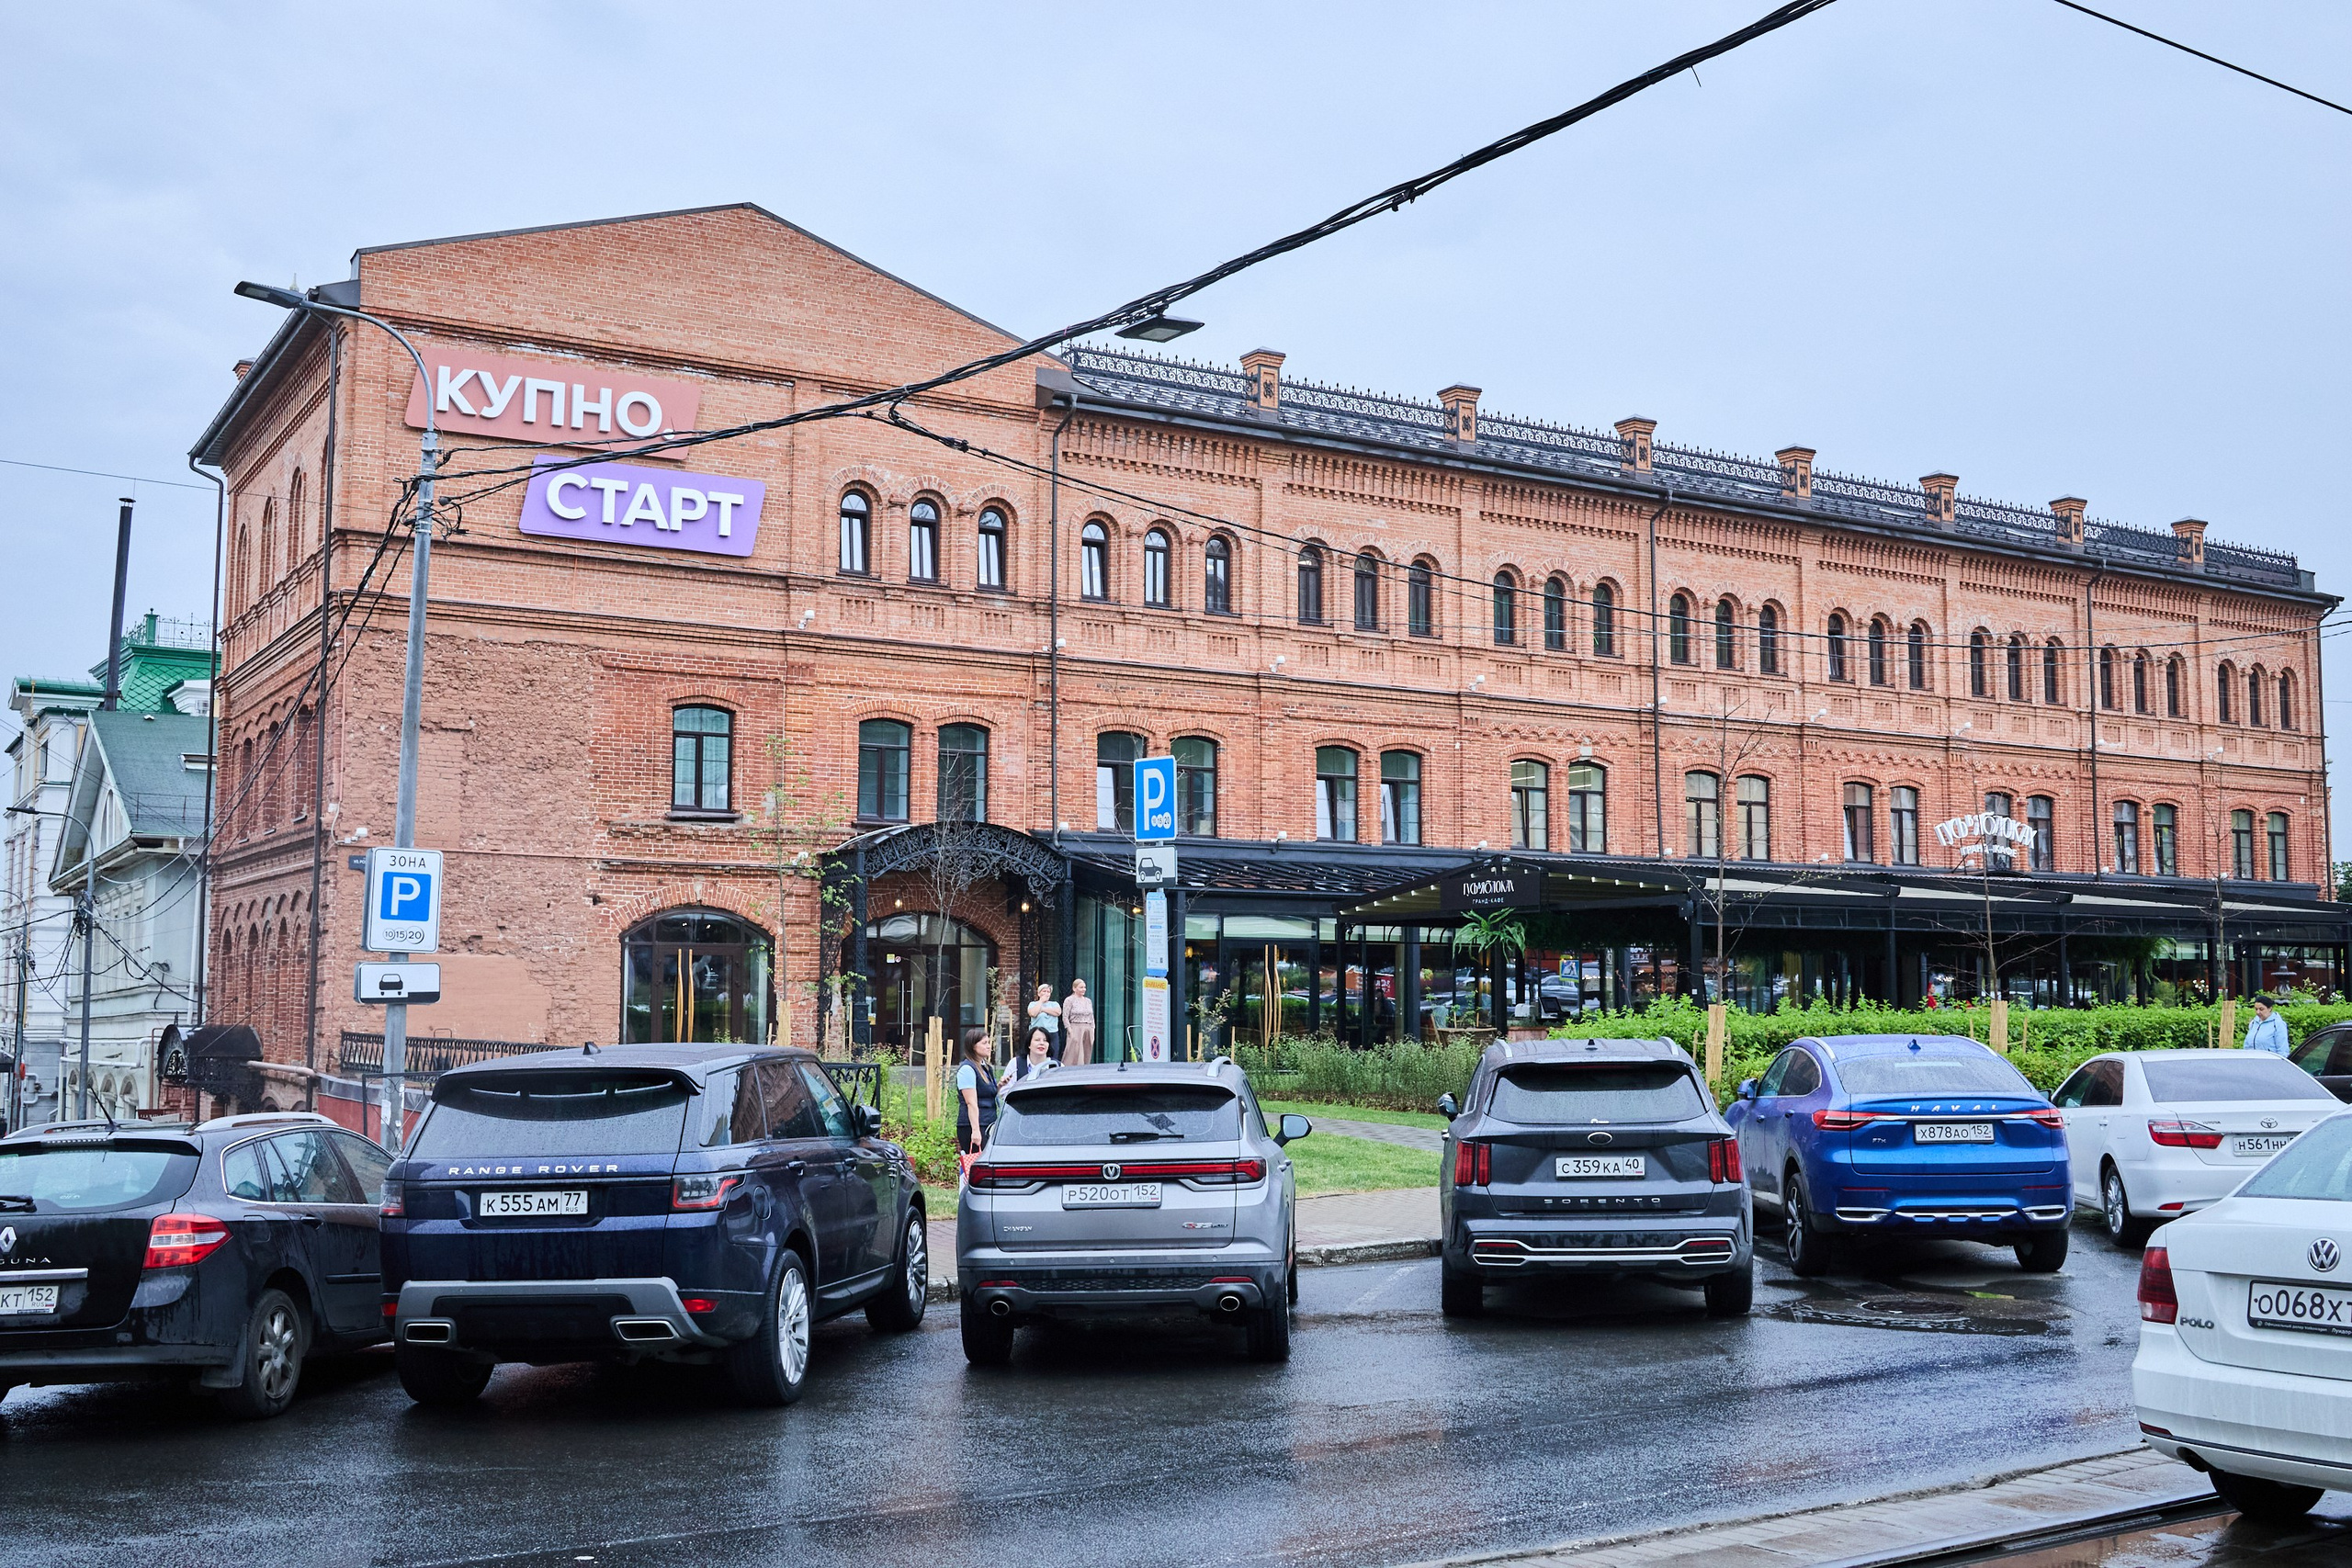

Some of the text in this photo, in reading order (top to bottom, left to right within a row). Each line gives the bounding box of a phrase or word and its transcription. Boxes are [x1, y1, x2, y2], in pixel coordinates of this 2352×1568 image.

[546, 472, 745, 537] СТАРТ
[1143, 768, 1166, 831] P
[1164, 816, 1170, 825] 20
[1960, 842, 2018, 858] ГРАНД-КАФЕ
[389, 855, 427, 869] ЗОНА
[390, 875, 422, 917] P
[1472, 897, 1504, 905] ГРАНД-КАФЕ
[396, 931, 405, 939] 15
[408, 931, 422, 940] 20
[1910, 1104, 1998, 1112] HAVAL
[1971, 1125, 1989, 1135] 152
[1625, 1158, 1640, 1169] 40
[448, 1164, 618, 1176] RANGE ROVER
[1134, 1184, 1158, 1196] 152
[564, 1192, 582, 1205] 77
[28, 1287, 53, 1302] 152
[2179, 1316, 2215, 1329] POLO
